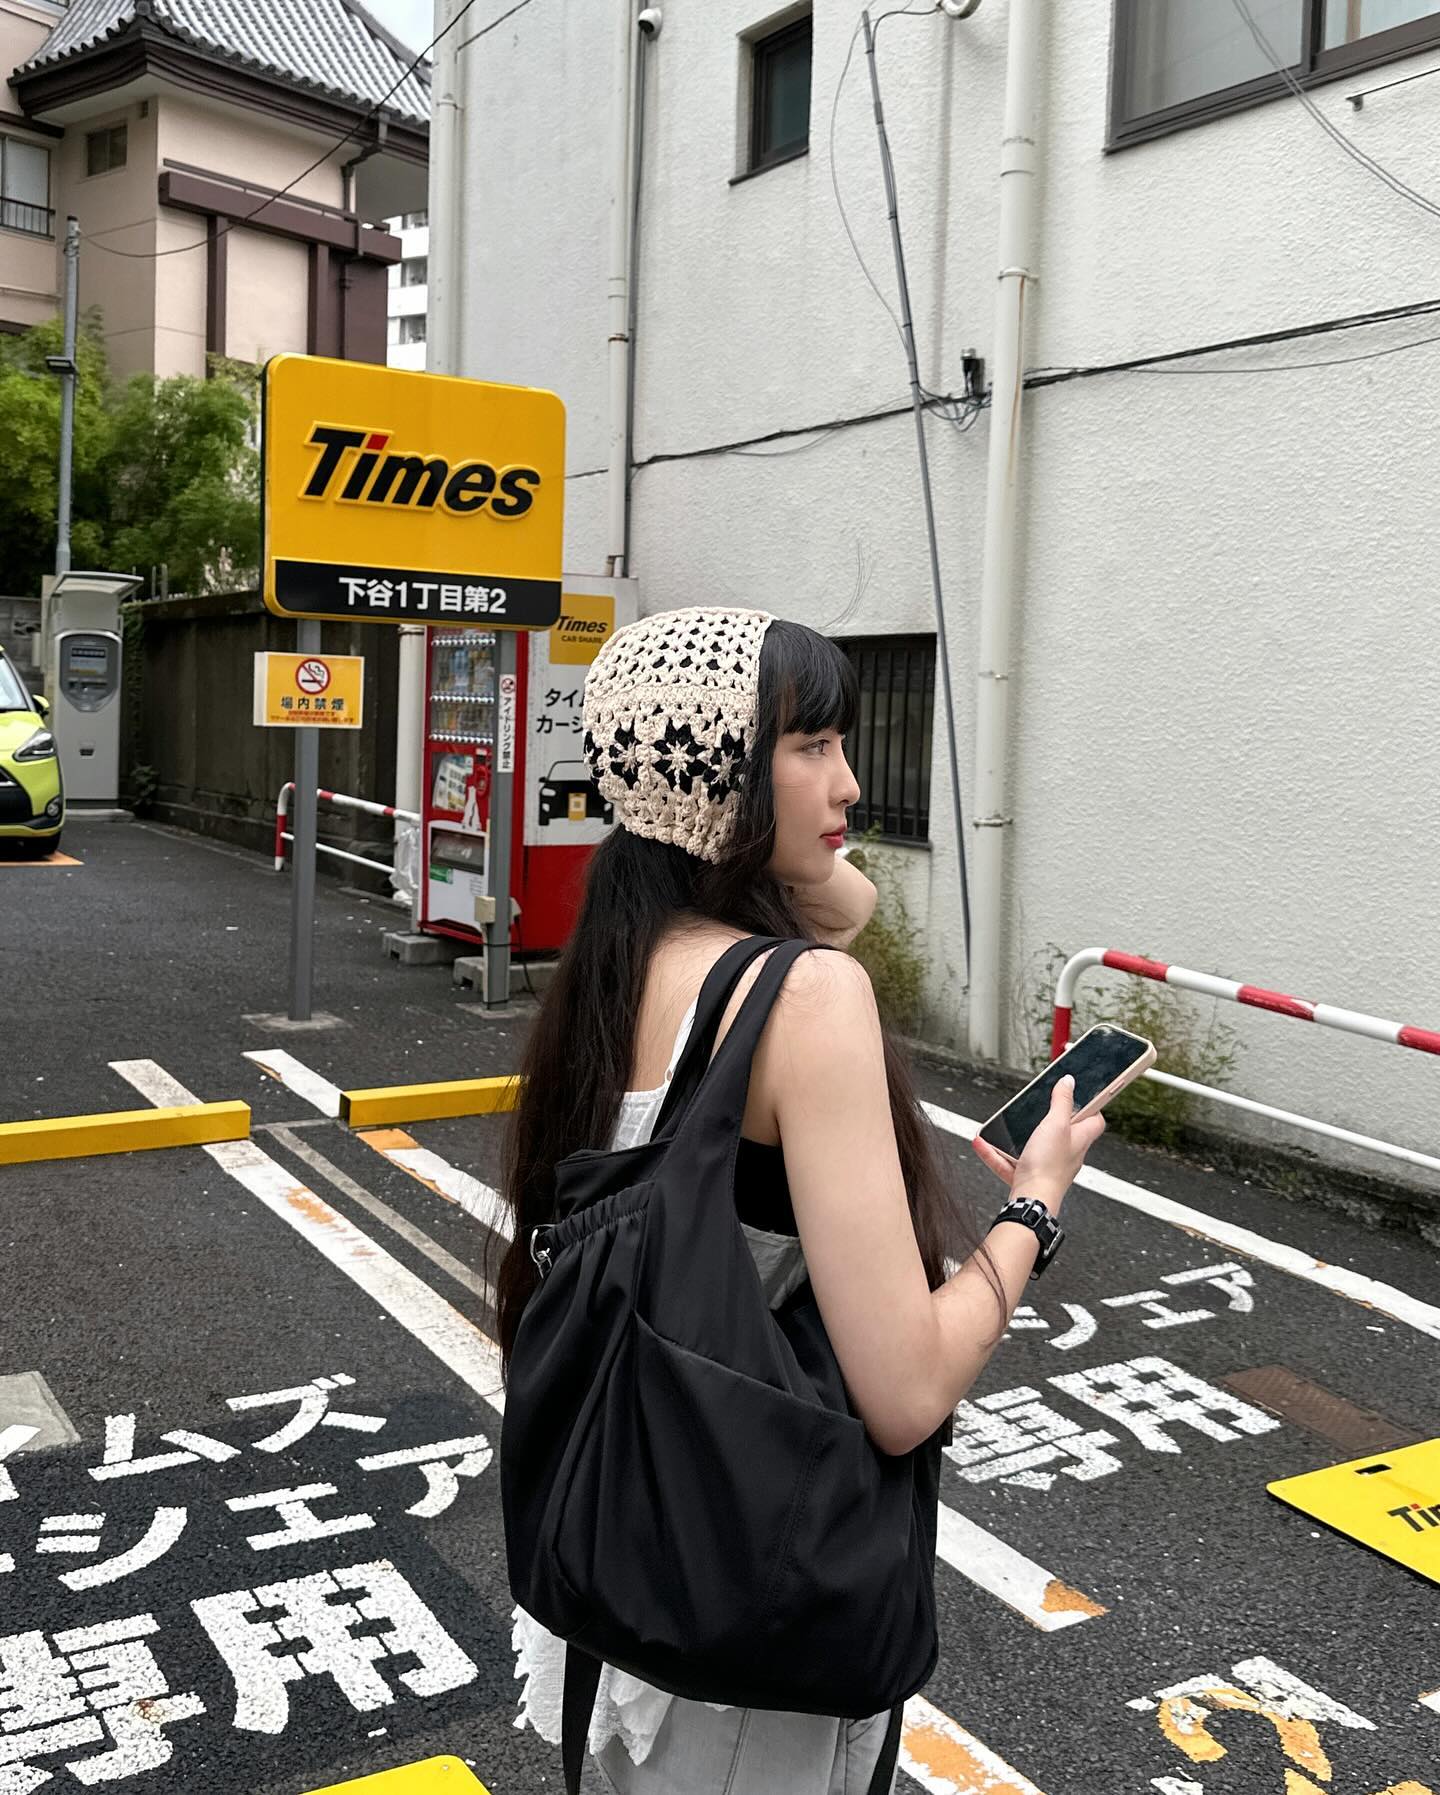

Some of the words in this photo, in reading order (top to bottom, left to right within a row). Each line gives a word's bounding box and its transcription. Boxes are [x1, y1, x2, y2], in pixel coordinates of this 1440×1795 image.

[302, 426, 541, 517] Times
[338, 577, 507, 614] 下谷1丁目第2
[557, 615, 608, 633] Times
